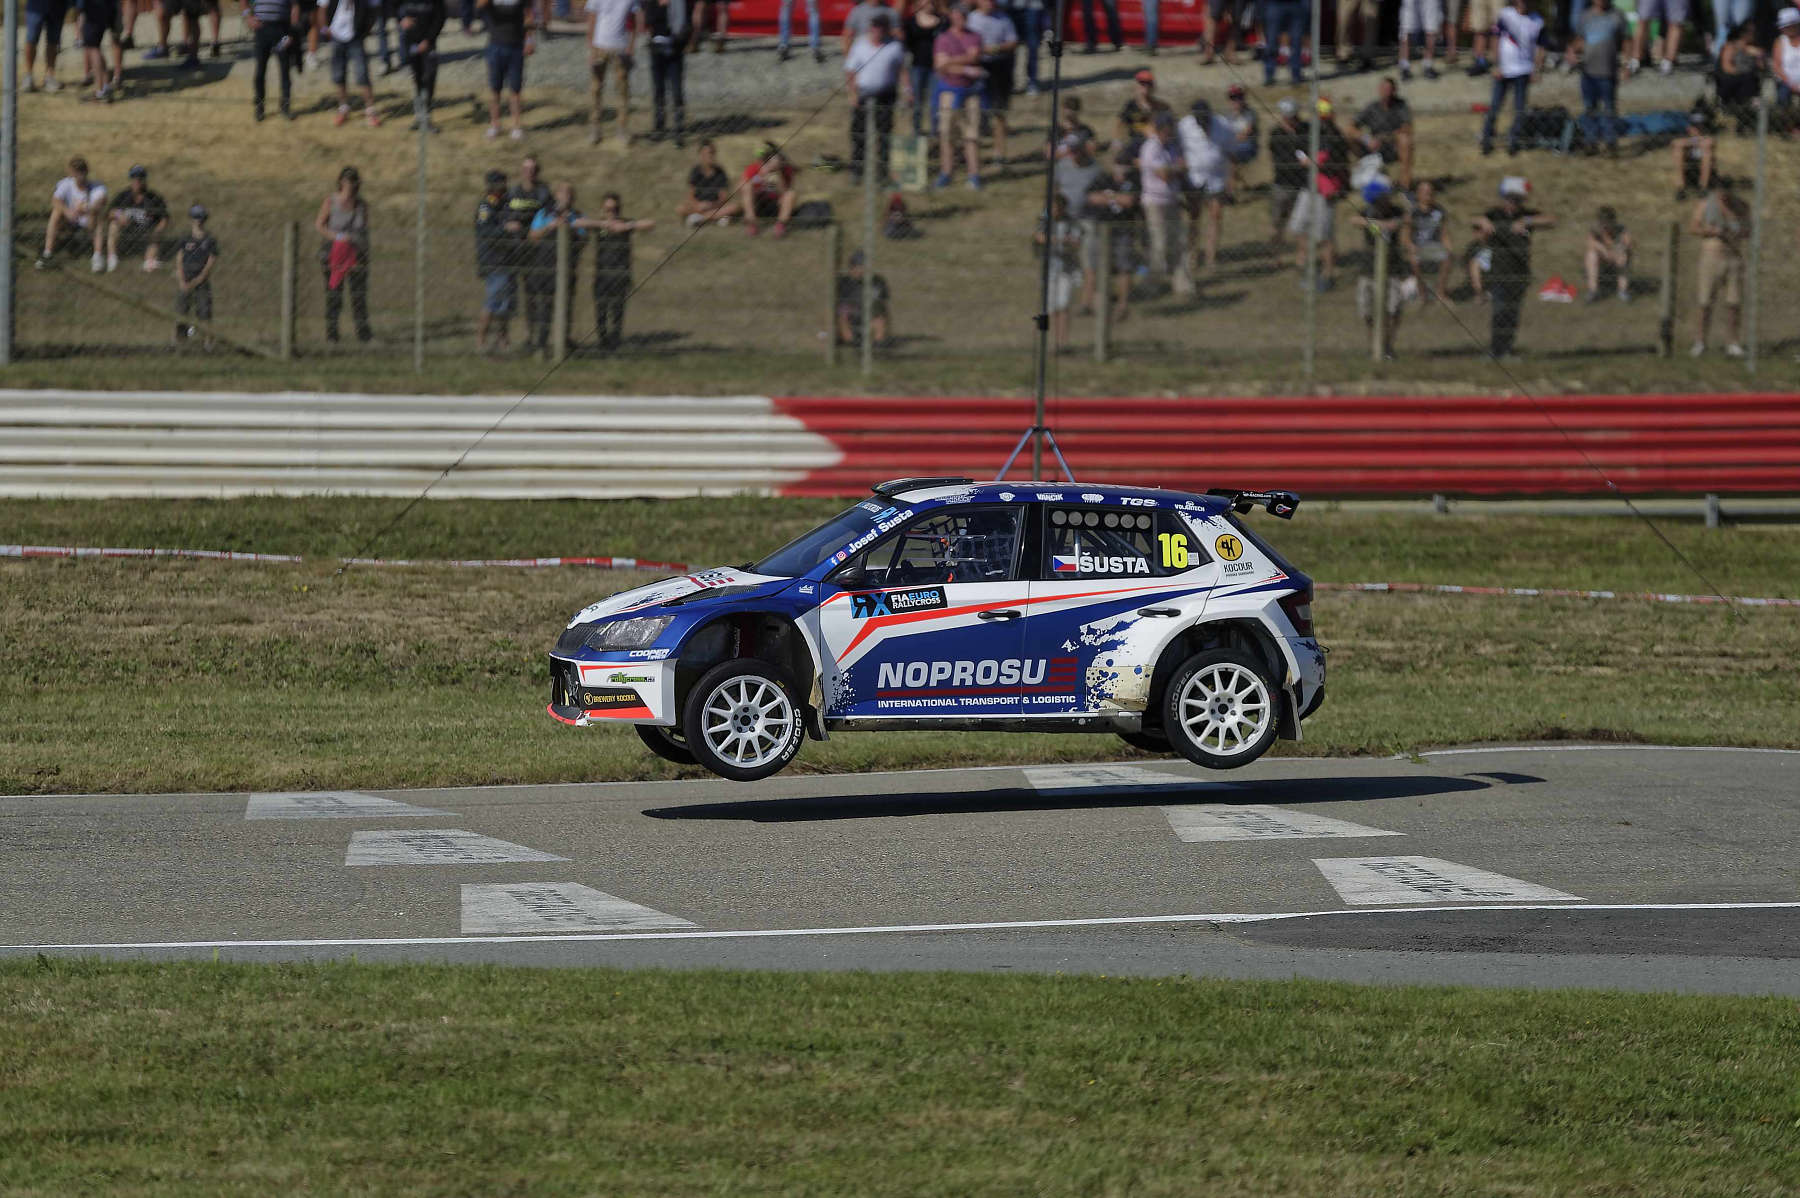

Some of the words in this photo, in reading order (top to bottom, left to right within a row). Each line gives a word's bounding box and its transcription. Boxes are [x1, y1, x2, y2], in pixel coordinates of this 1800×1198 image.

[848, 529, 879, 554] Josef
[878, 509, 914, 533] Susta
[1080, 551, 1150, 574] ŠUSTA
[1157, 533, 1188, 569] 16
[1223, 561, 1254, 573] KOCOUR
[892, 597, 941, 609] RALLYCROSS
[878, 697, 958, 708] INTERNATIONAL
[959, 695, 1020, 706] TRANSPORT
[1023, 695, 1030, 704] &
[1032, 695, 1076, 705] LOGISTIC
[782, 707, 802, 761] COOPER
